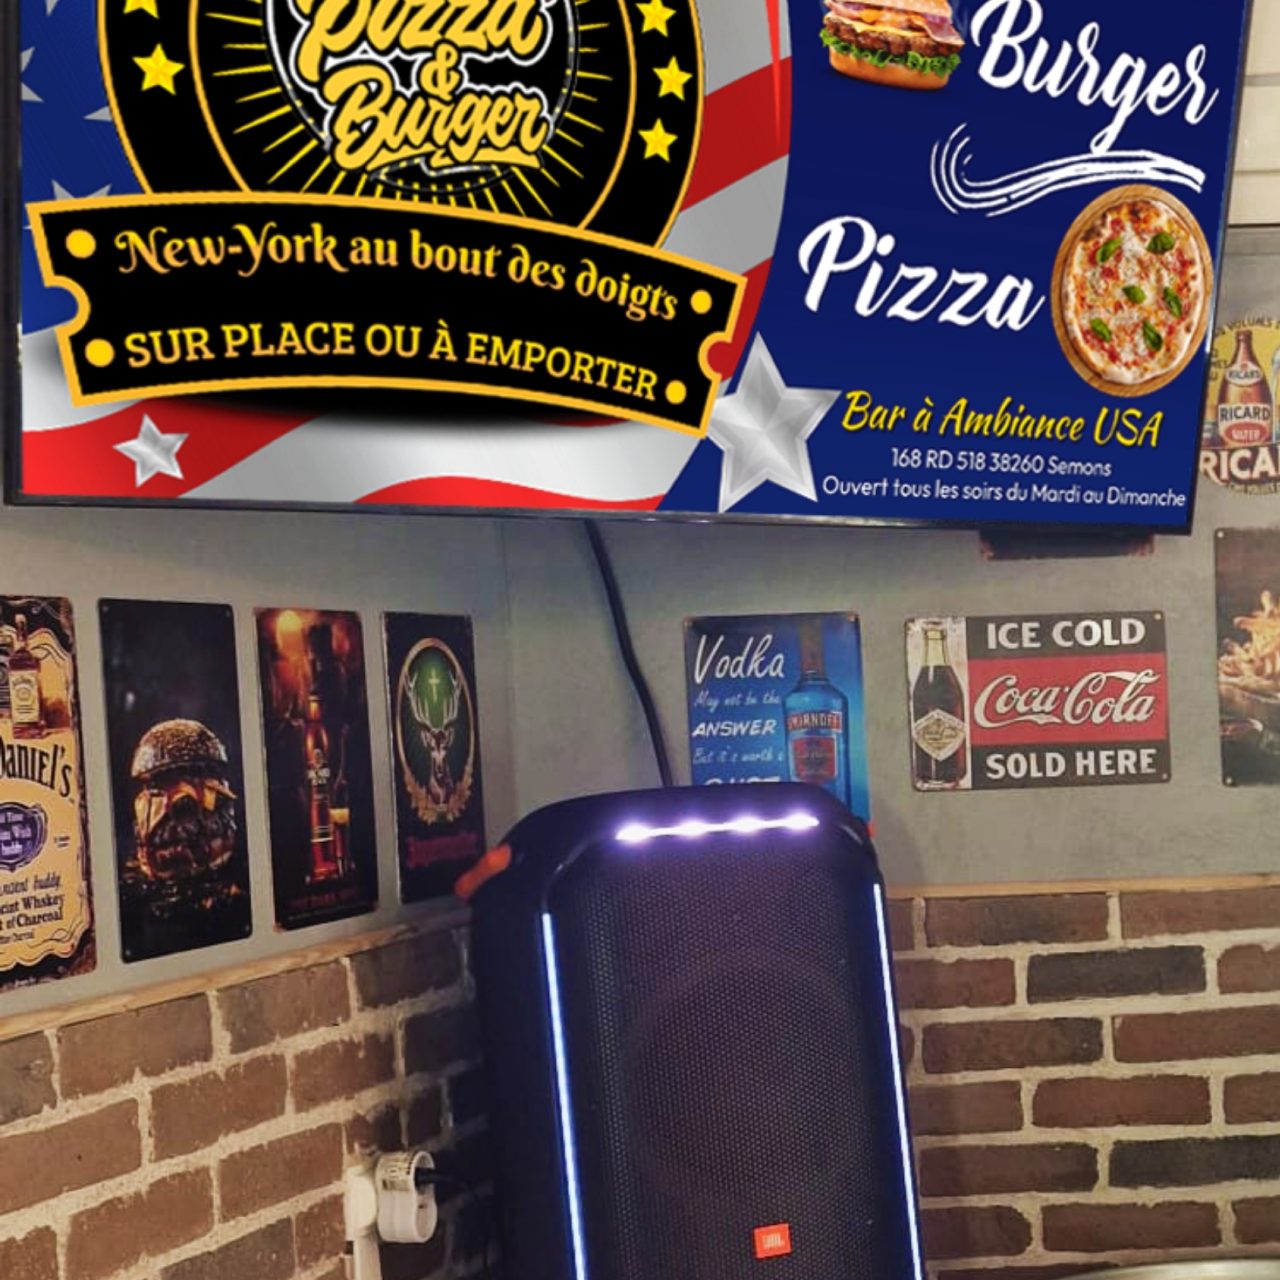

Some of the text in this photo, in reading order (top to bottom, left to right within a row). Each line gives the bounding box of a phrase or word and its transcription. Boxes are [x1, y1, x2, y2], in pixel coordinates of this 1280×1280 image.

[297, 0, 547, 78] Pizza
[418, 46, 463, 93] &
[969, 0, 1220, 155] Burger
[324, 66, 551, 171] Burger
[115, 222, 680, 321] New-York au bout des doigts
[799, 214, 1046, 332] Pizza
[124, 318, 659, 401] SUR PLACE OU À EMPORTER
[840, 388, 1165, 449] Bar à Ambiance USA
[1219, 405, 1272, 422] RICARD
[891, 447, 1112, 477] 168 RD 518 38260 Semons
[822, 475, 1187, 508] Ouvert tous les soirs du Mardi au Dimanche
[693, 633, 786, 685] Vodka
[986, 617, 1146, 650] ICE COLD
[692, 719, 778, 738] ANSWER
[985, 748, 1158, 781] SOLD HERE
